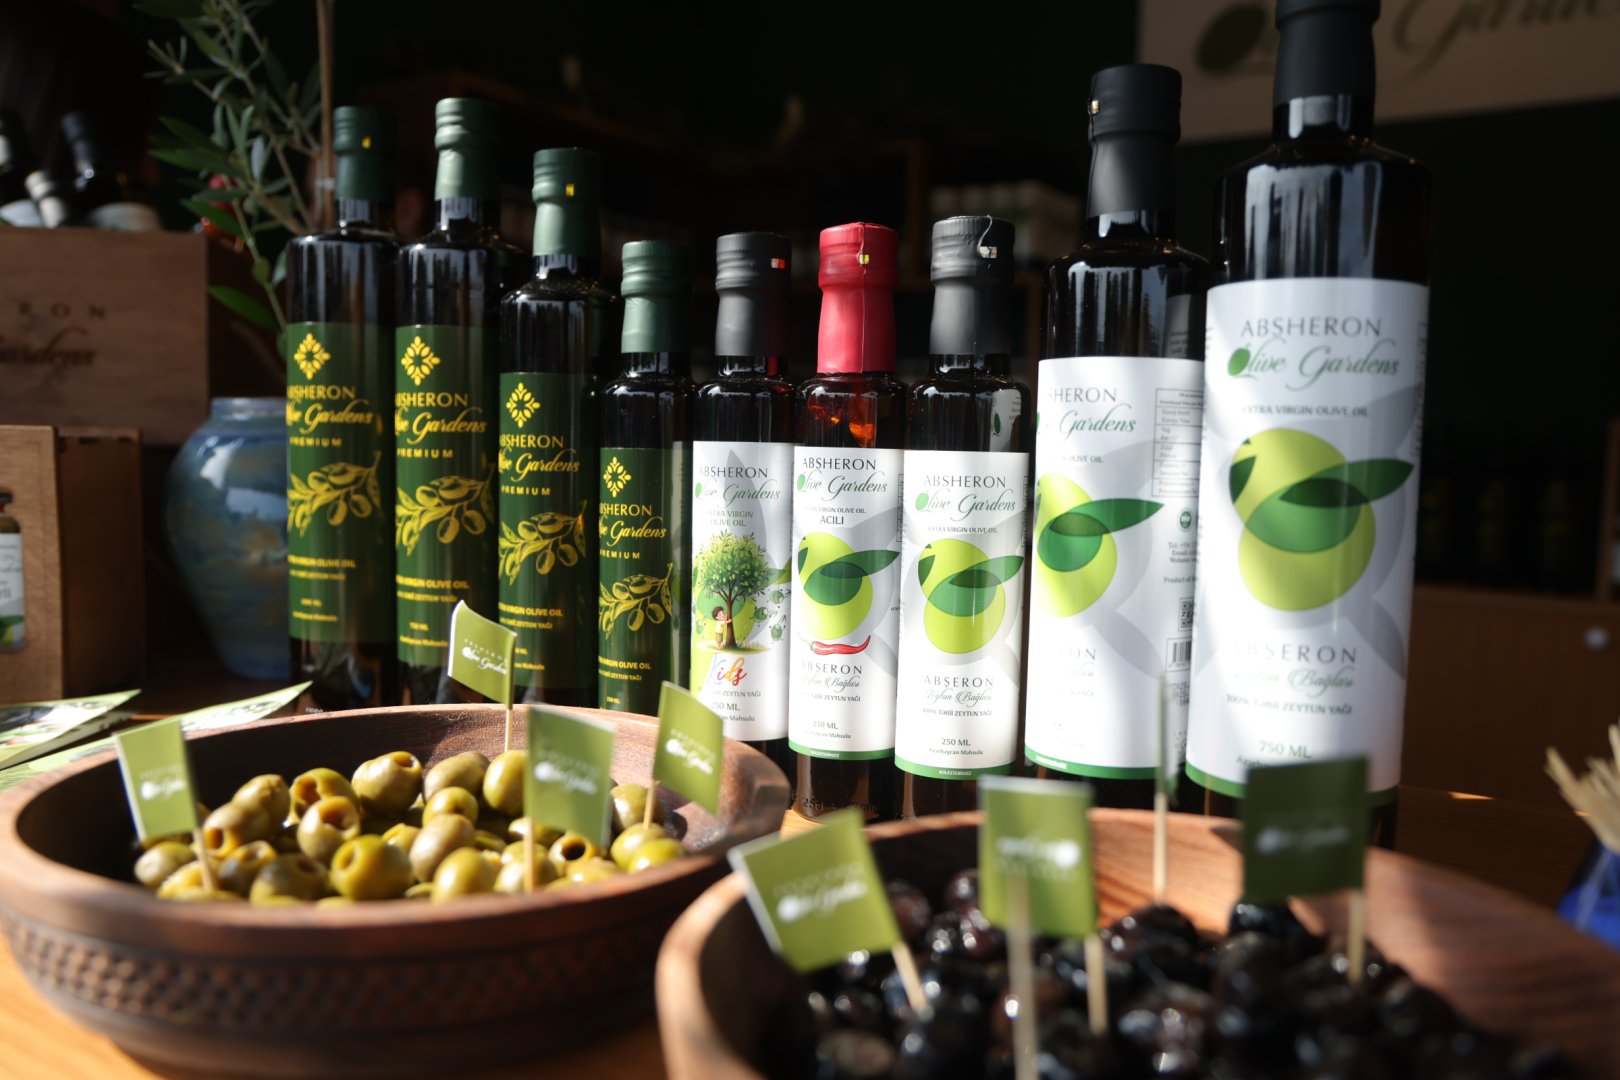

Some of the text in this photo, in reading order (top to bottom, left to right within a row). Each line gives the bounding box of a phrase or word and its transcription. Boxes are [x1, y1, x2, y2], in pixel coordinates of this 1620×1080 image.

[1240, 316, 1382, 338] ABSHERON
[1285, 338, 1400, 392] Gardens
[298, 399, 375, 435] Gardens
[1276, 406, 1313, 416] VIRGIN
[1316, 406, 1350, 417] OLIVE
[1352, 407, 1370, 417] OIL
[406, 406, 488, 445] Gardens
[1058, 402, 1137, 441] Gardens
[510, 448, 581, 483] Gardens
[803, 457, 877, 471] ABSHERON
[700, 466, 769, 479] ABSHERON
[820, 471, 888, 502] Gardens
[923, 475, 1007, 489] ABSHERON
[501, 485, 551, 496] PREMIUM
[722, 478, 781, 508] Gardens
[950, 488, 1016, 522] Gardens
[732, 519, 748, 527] OIL
[820, 515, 844, 525] ACILI
[606, 515, 668, 547] Gardens
[425, 579, 451, 589] OLIVE
[452, 580, 470, 590] OIL
[525, 607, 548, 616] OLIVE
[549, 608, 563, 617] OIL
[619, 660, 639, 669] OLIVE
[639, 661, 653, 670] OIL
[708, 653, 748, 687] Kids
[726, 703, 741, 711] ML
[1282, 701, 1327, 714] ZEYTUN
[941, 738, 971, 747] 250 ML
[1259, 740, 1313, 759] 750 ML
